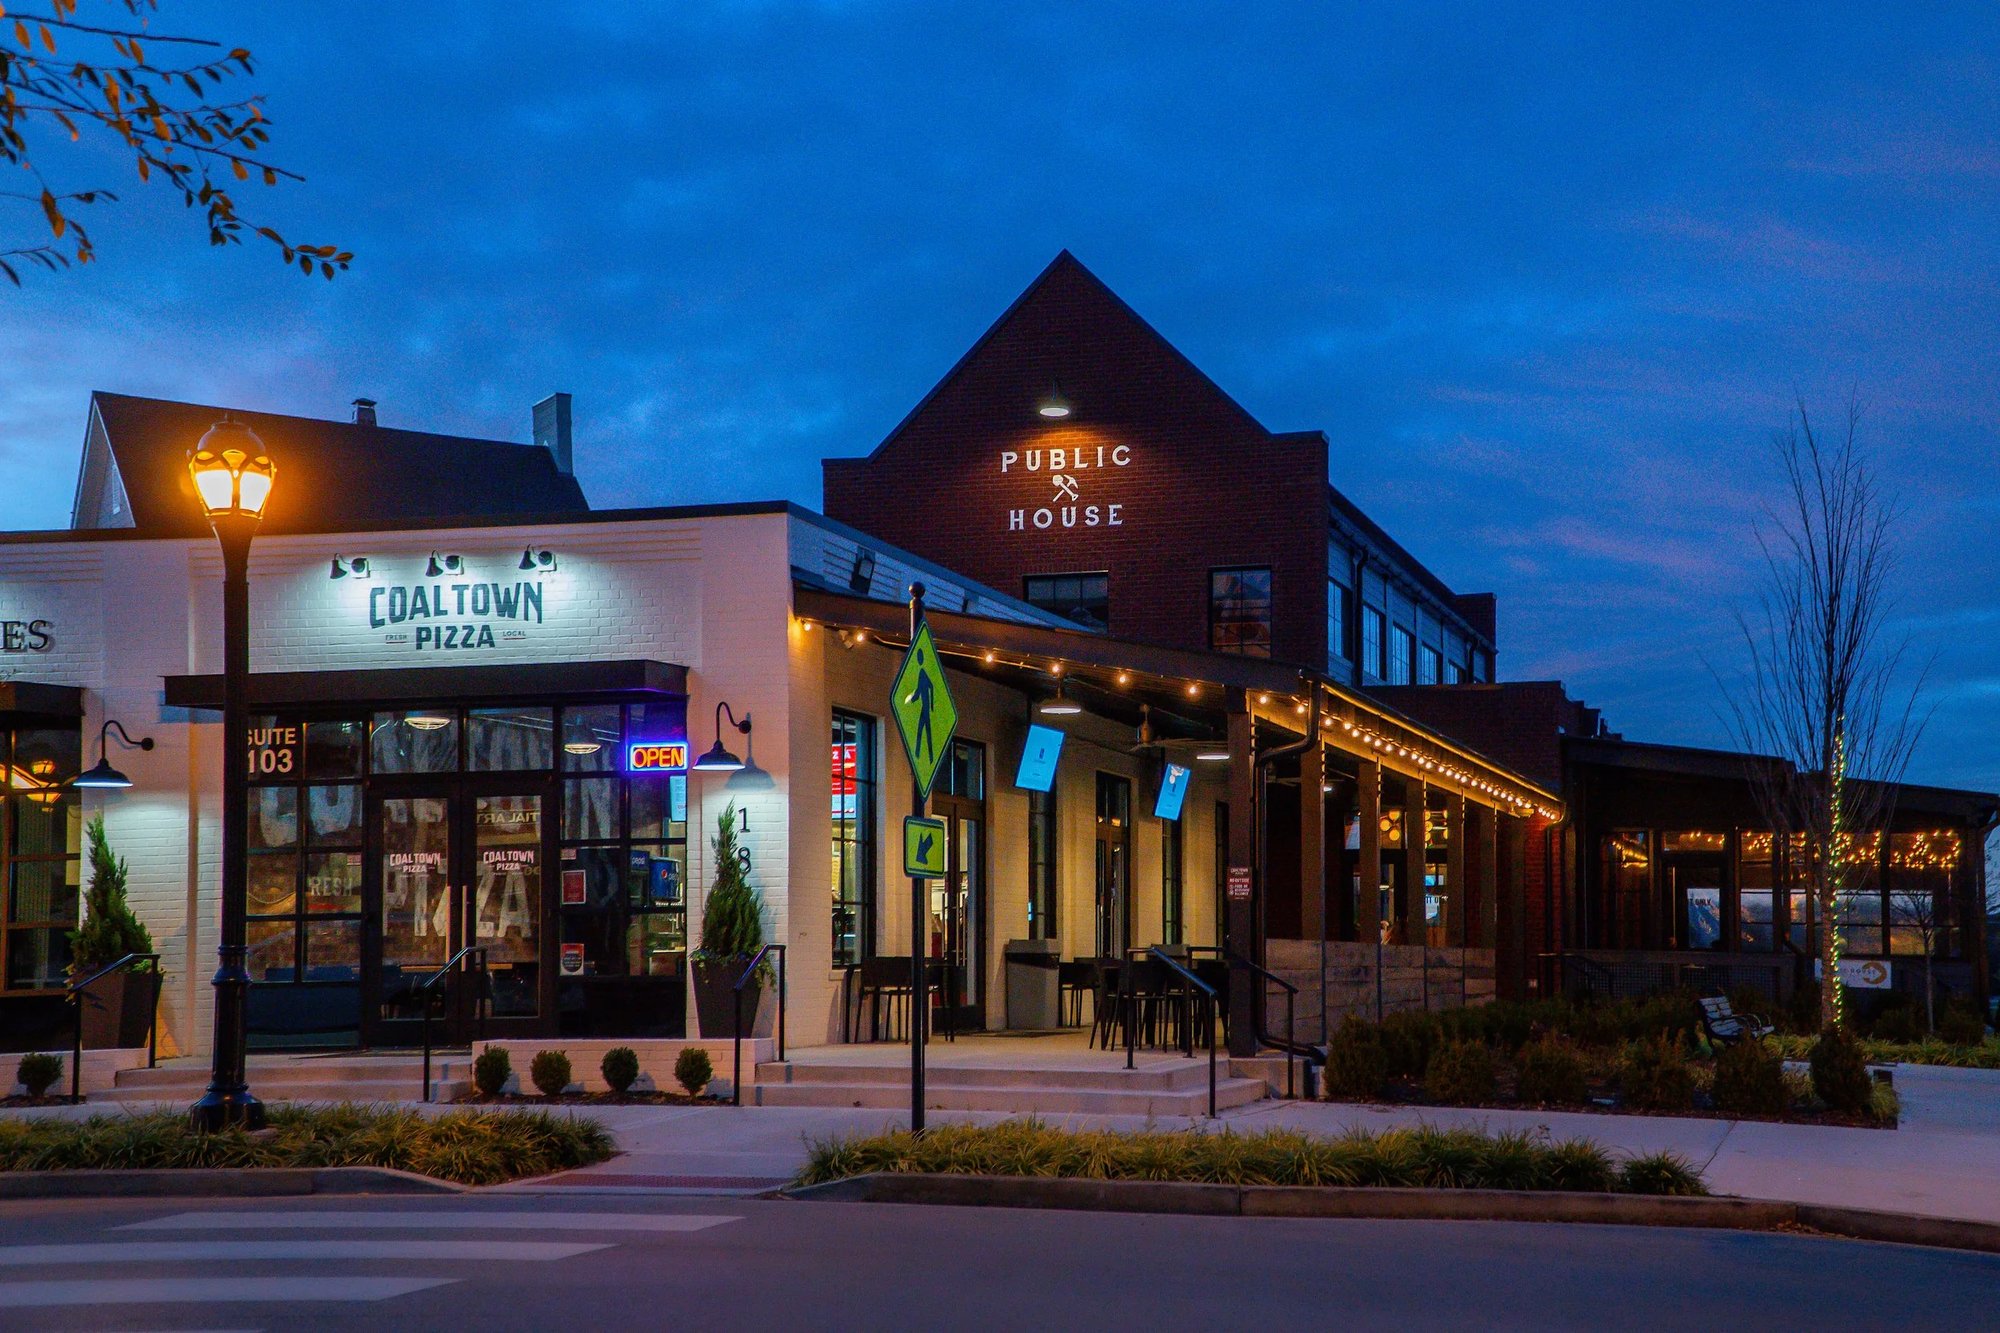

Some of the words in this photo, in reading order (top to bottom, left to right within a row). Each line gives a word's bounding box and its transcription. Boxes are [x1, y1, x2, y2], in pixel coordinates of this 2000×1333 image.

[1001, 445, 1131, 472] PUBLIC
[1009, 505, 1123, 531] HOUSE
[369, 582, 542, 629] COALTOWN
[0, 620, 49, 650] ES
[416, 624, 496, 650] PIZZA
[247, 748, 293, 774] 103
[632, 747, 684, 768] OPEN
[389, 852, 441, 867] COALTOWN
[402, 865, 427, 873] PIZZA
[483, 850, 534, 865] COALTOWN
[496, 862, 521, 871] PIZZA
[307, 876, 352, 896] RESH
